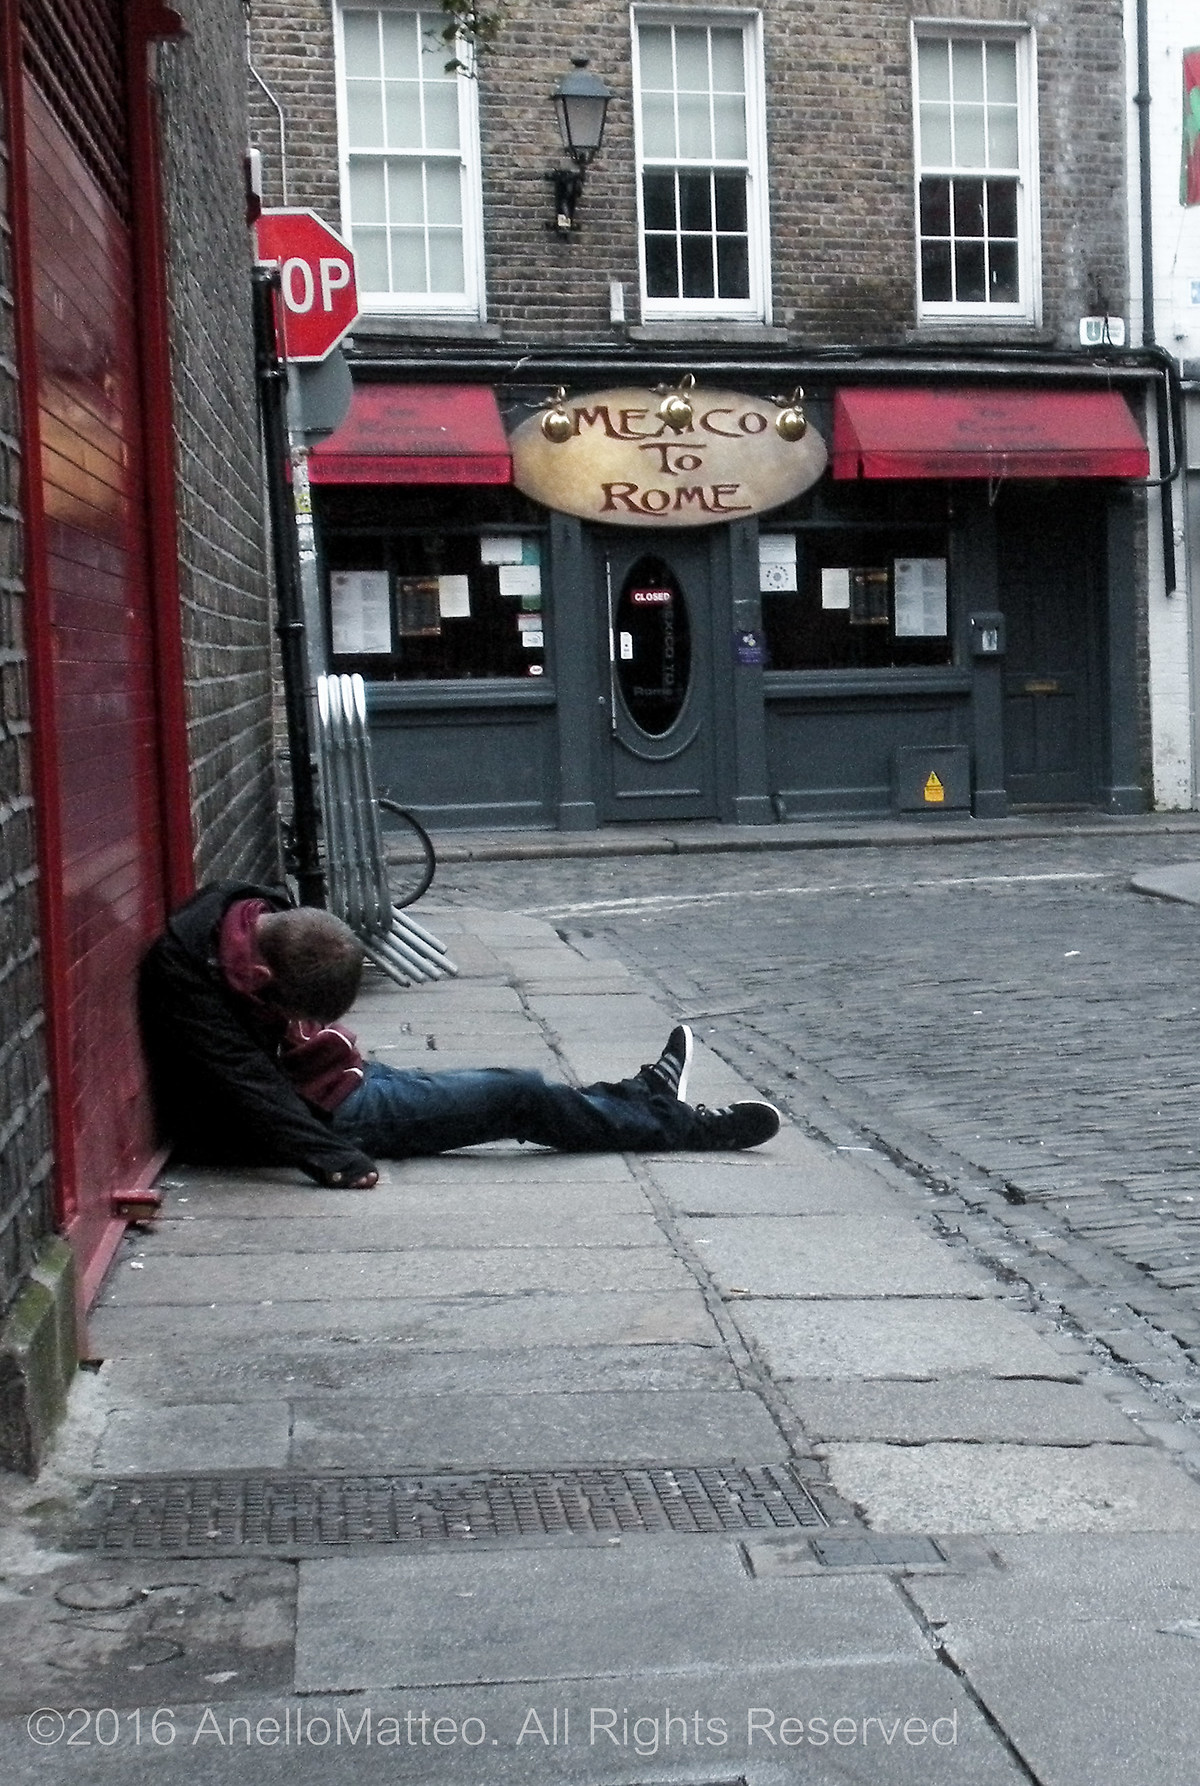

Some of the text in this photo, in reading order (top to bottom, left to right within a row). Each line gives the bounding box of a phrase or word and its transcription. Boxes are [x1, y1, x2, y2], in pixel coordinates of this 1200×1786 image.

[255, 257, 350, 314] OP
[599, 481, 752, 516] ROME
[634, 592, 672, 602] CLOSED
